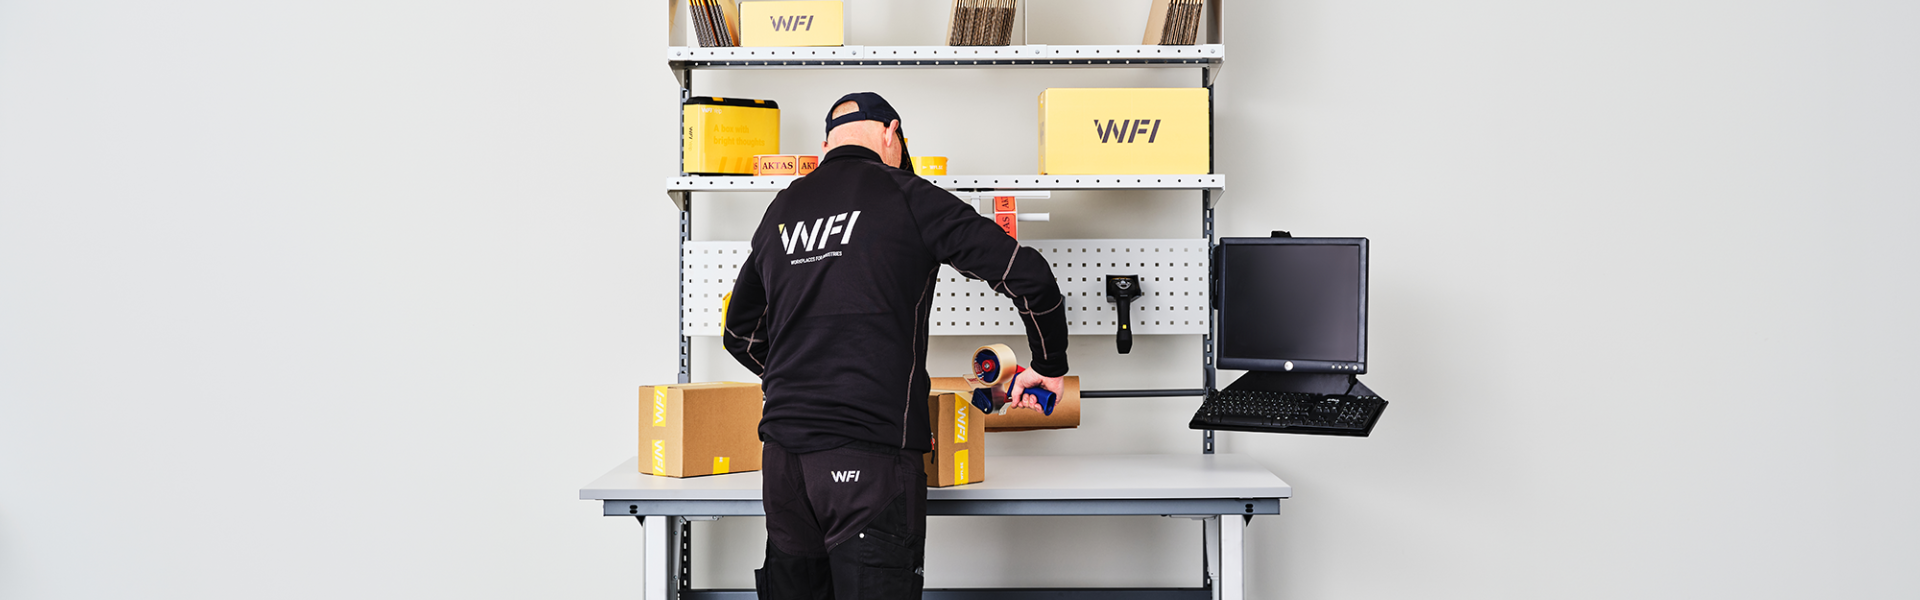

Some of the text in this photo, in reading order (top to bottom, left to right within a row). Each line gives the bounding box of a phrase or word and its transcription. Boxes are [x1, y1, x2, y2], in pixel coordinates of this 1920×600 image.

[770, 15, 814, 32] WFI
[713, 124, 750, 134] A box with
[1093, 119, 1161, 143] WFI
[713, 136, 765, 148] bright thoughts
[762, 162, 793, 170] AKTAS
[778, 210, 861, 255] WFI
[655, 390, 665, 424] WFI
[957, 406, 967, 441] WFI
[654, 440, 664, 473] WFI
[830, 470, 860, 483] WFI
